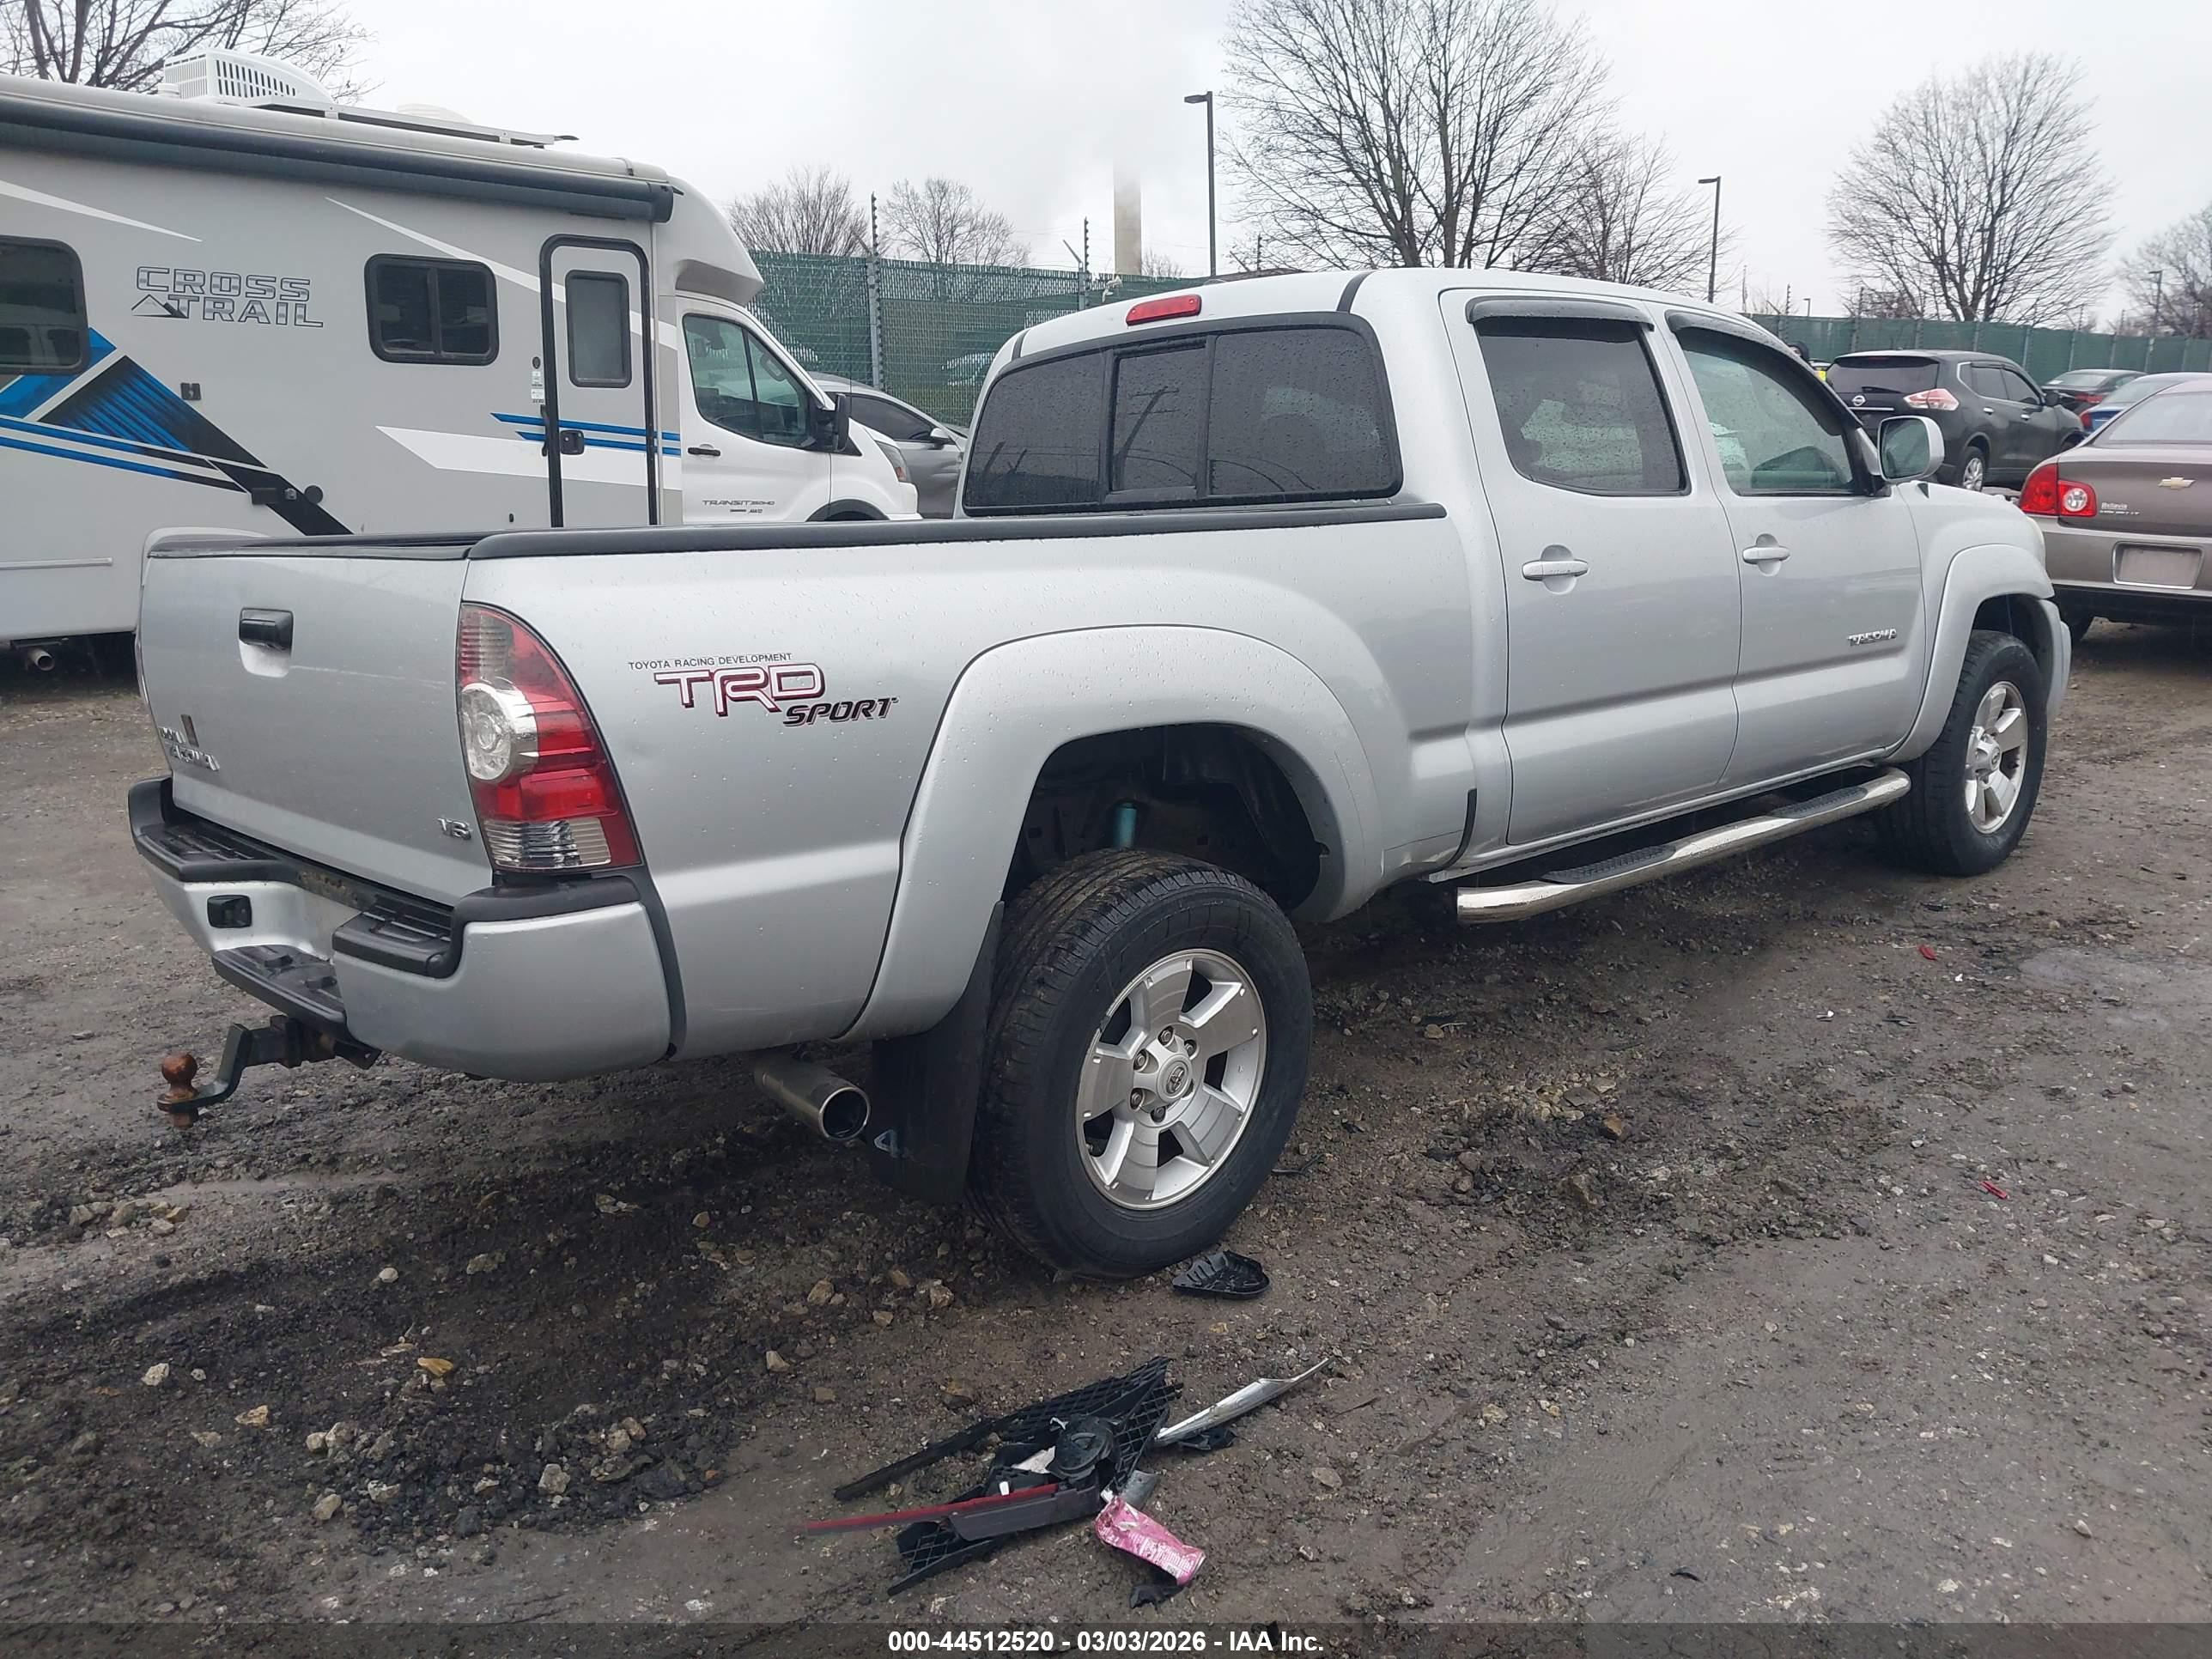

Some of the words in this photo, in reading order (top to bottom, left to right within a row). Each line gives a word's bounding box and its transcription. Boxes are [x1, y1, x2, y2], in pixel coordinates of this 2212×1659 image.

[137, 266, 311, 302] CROSS
[167, 294, 324, 328] TRAIL
[629, 660, 672, 671] TOYOTA
[674, 657, 715, 668] RACING
[719, 653, 793, 665] DEVELOPMENT
[653, 662, 826, 718] TRD
[782, 696, 899, 728] SPORT
